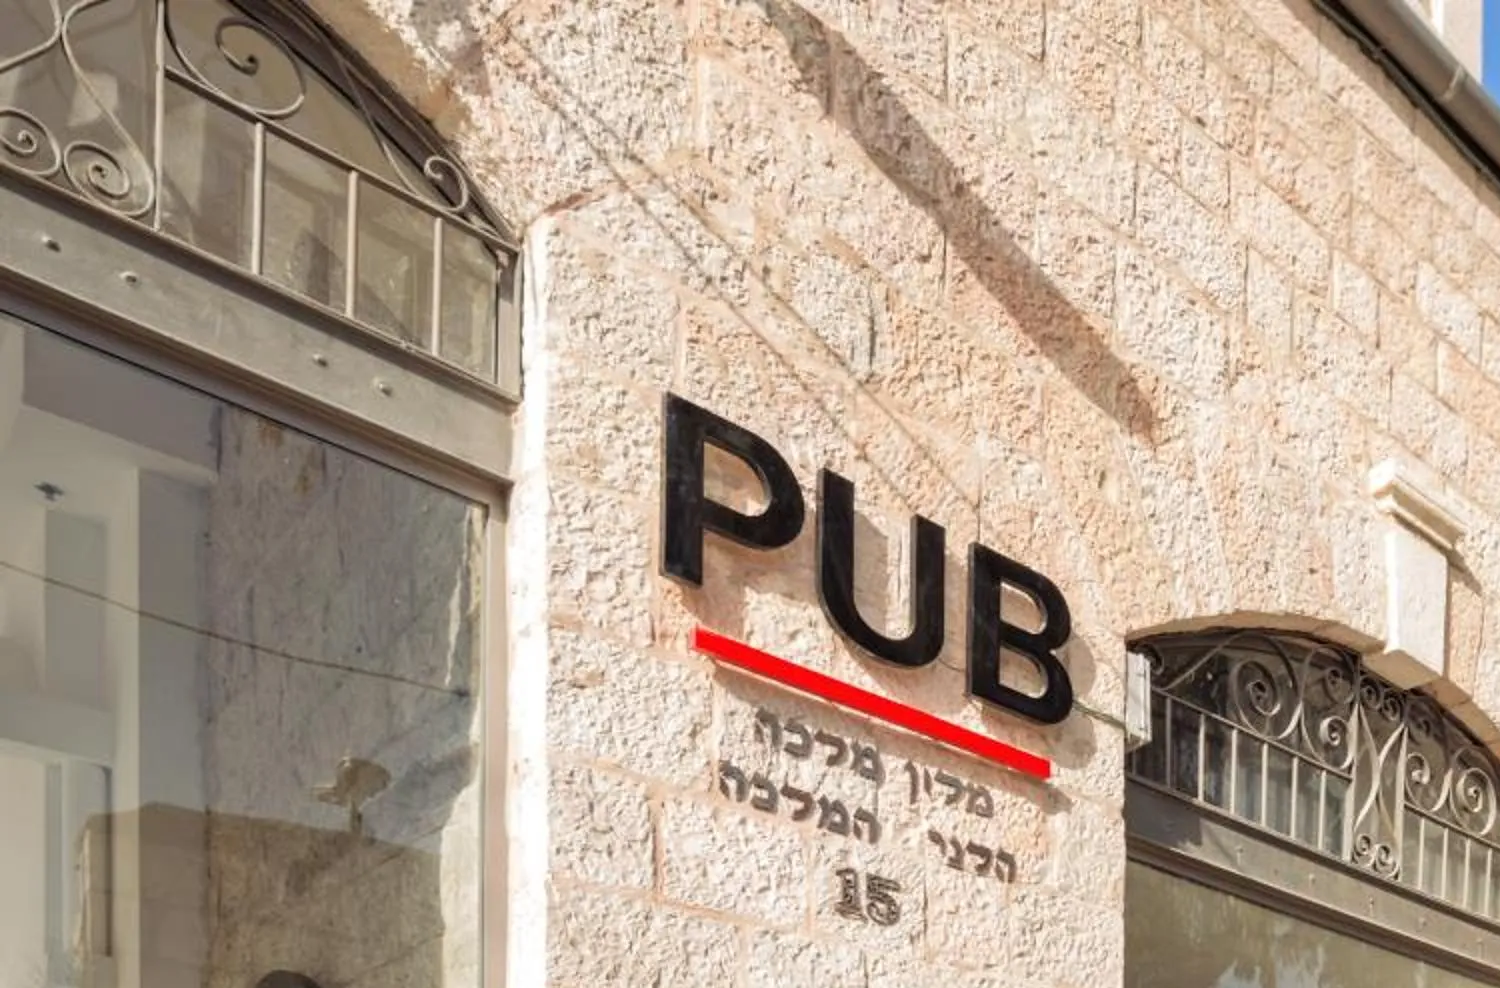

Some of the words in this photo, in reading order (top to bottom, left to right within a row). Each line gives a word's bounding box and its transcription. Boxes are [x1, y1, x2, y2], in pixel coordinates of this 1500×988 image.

[659, 391, 1075, 726] PUB
[754, 706, 886, 788] מלכה
[718, 759, 883, 844] המלכה
[903, 760, 994, 818] מלון
[928, 829, 1017, 884] הלני
[833, 867, 902, 926] 15
